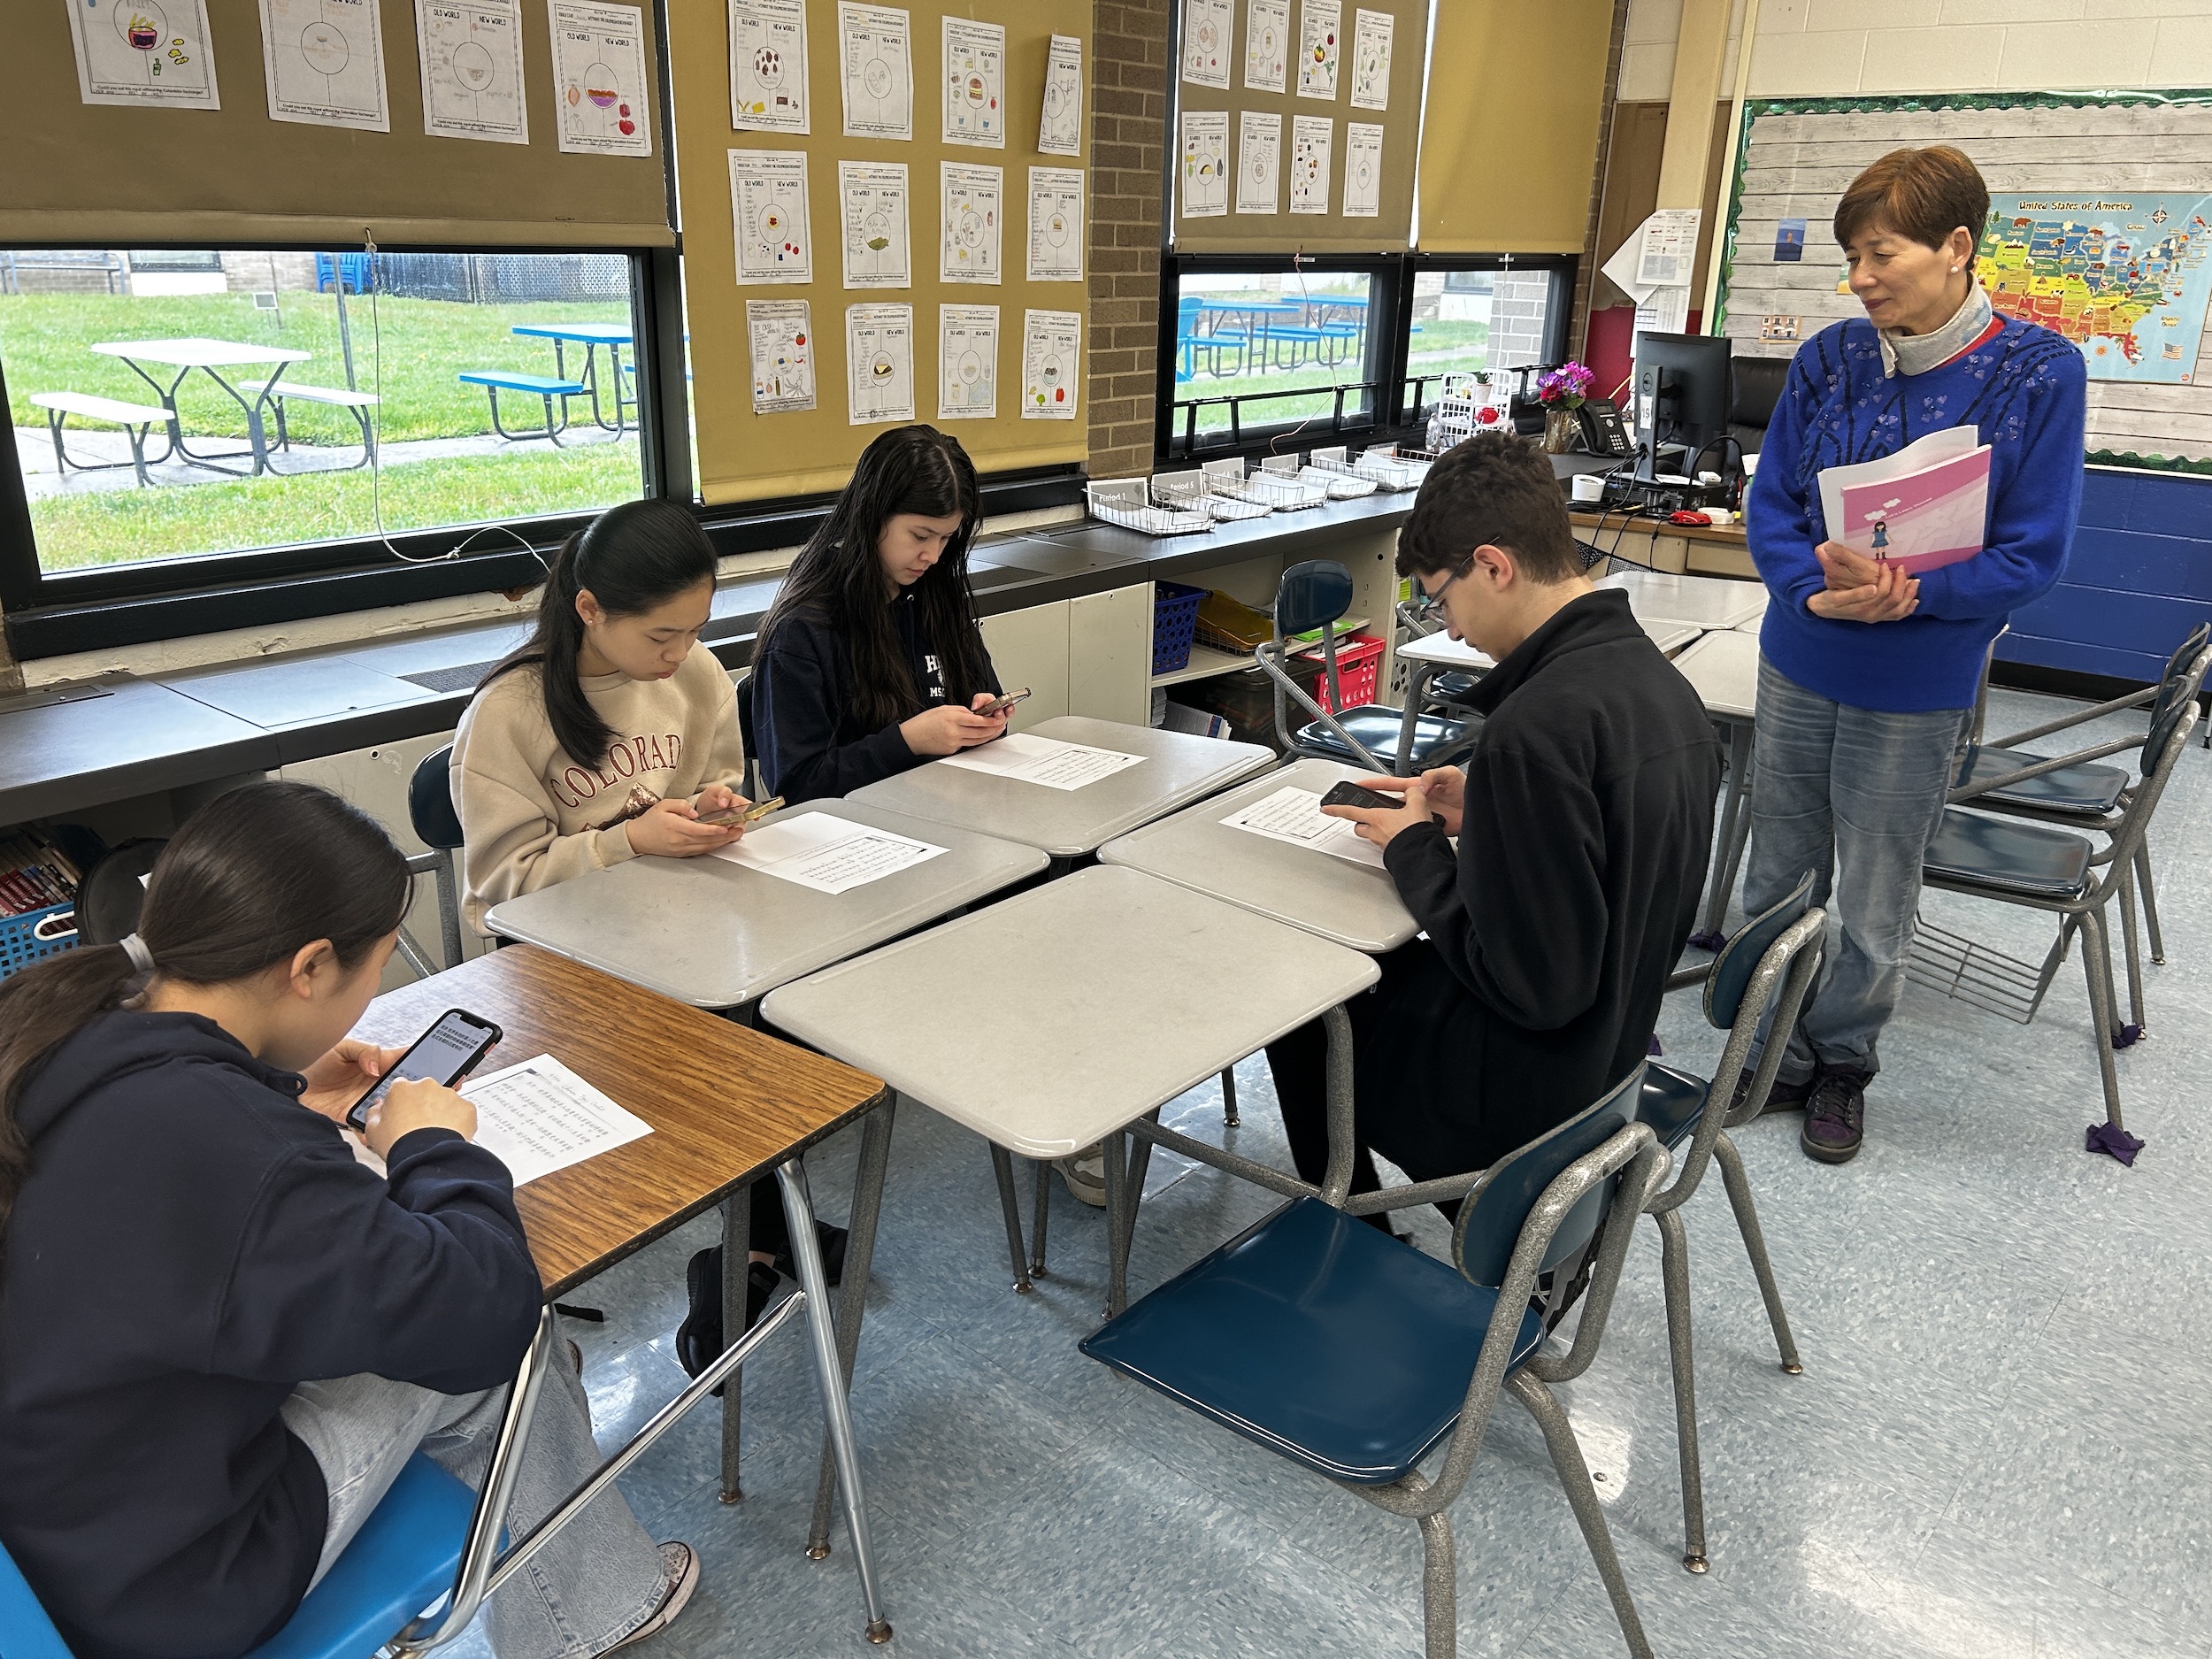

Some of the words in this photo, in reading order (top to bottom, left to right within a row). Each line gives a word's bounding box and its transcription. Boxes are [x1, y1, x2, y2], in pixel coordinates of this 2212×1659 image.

[443, 11, 460, 19] WORLD
[2019, 201, 2047, 211] United
[2051, 202, 2078, 211] States
[2081, 201, 2092, 211] of
[2094, 201, 2132, 211] America
[1099, 492, 1121, 502] Period
[925, 655, 939, 673] H
